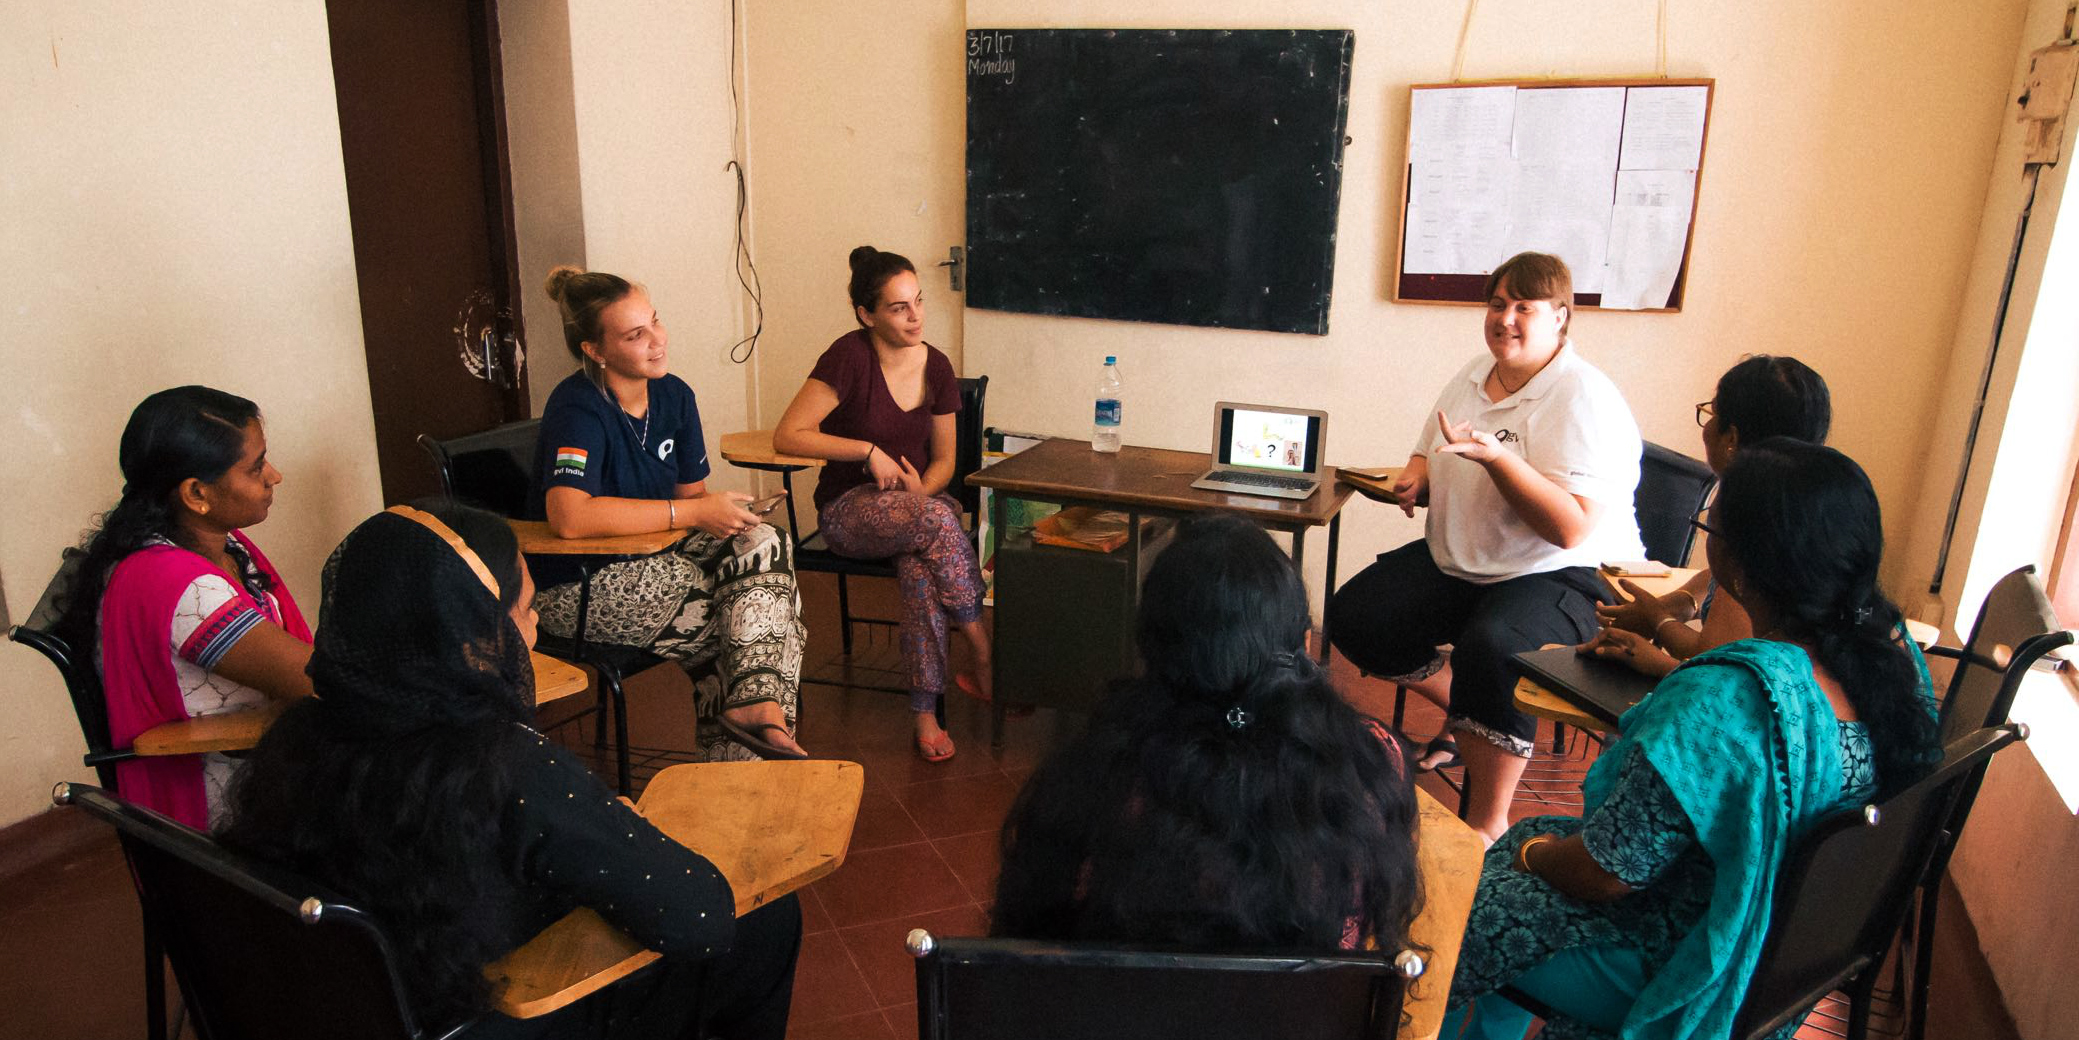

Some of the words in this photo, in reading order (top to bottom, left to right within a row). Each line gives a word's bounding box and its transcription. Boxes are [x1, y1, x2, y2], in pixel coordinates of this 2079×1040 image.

[968, 31, 1013, 56] 3/7/17
[968, 53, 1015, 85] Monday
[565, 467, 584, 477] India
